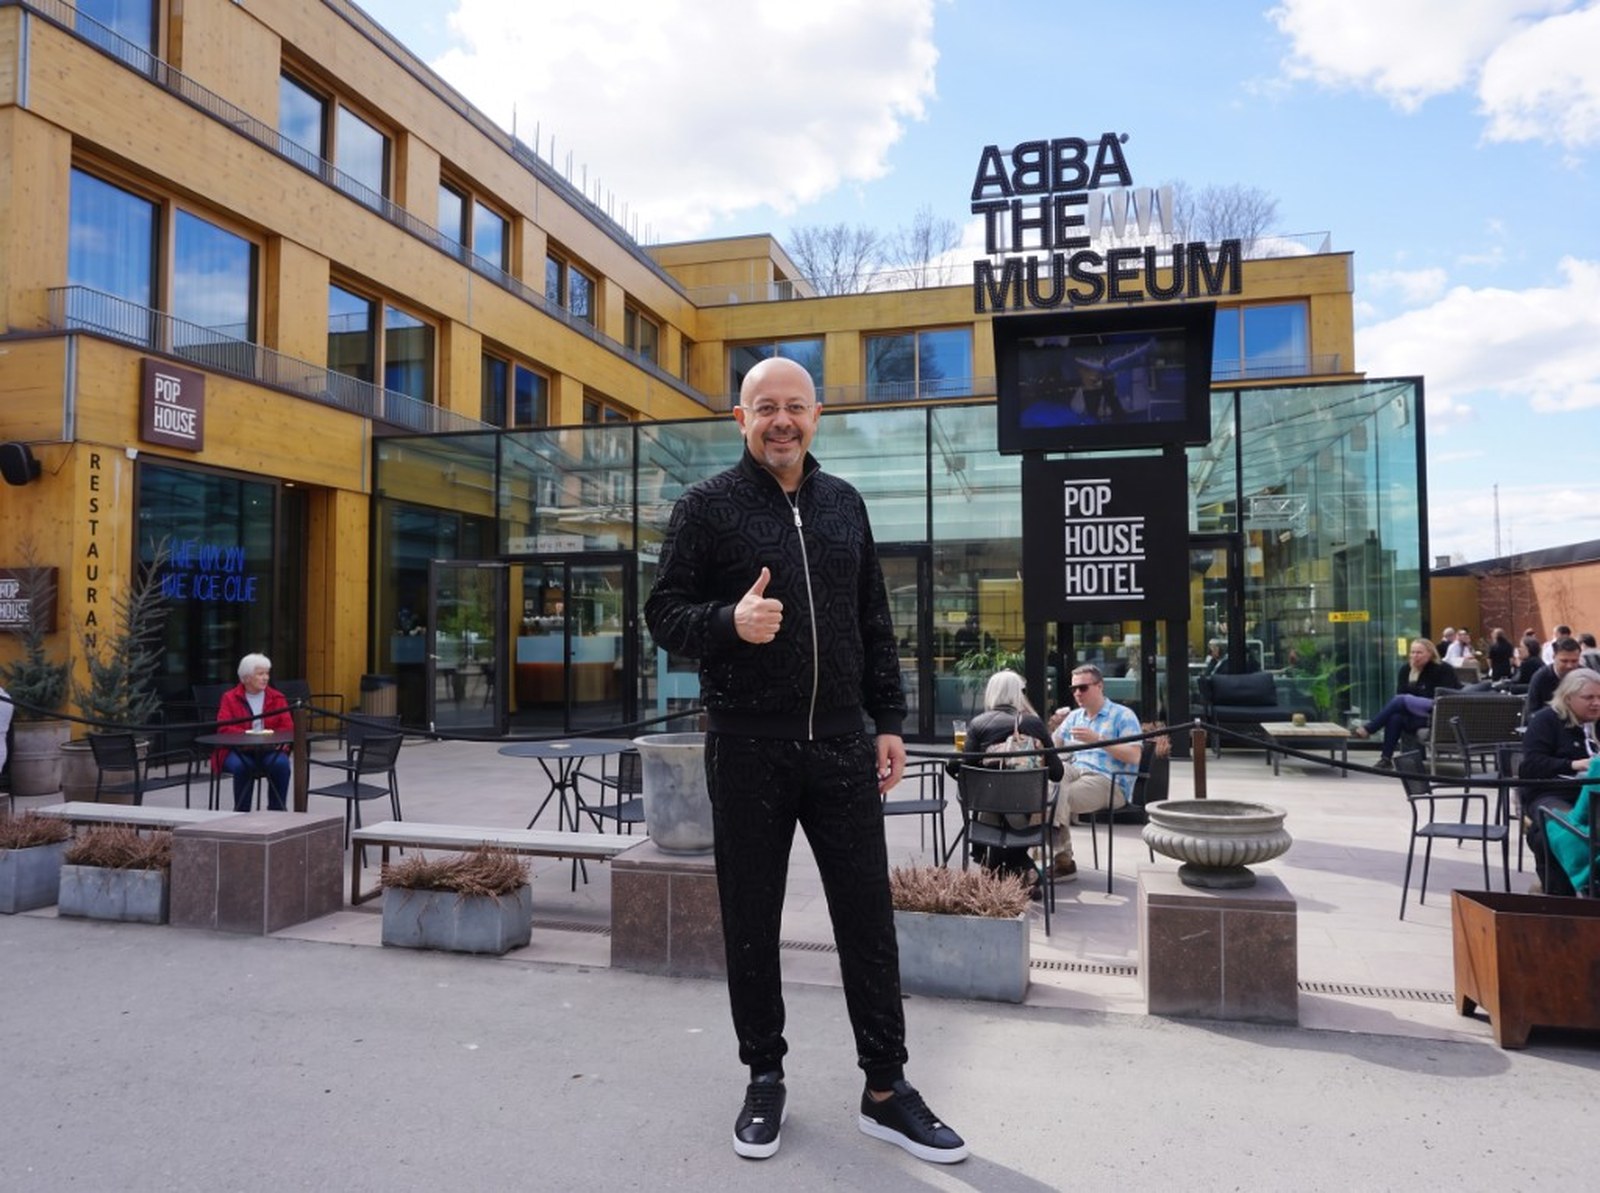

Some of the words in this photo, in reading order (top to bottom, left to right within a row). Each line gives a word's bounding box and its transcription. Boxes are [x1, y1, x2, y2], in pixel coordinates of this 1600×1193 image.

[971, 132, 1132, 201] ABBA
[971, 193, 1091, 255] THE
[973, 238, 1242, 314] MUSEUM
[155, 378, 181, 403] POP
[154, 405, 197, 434] HOUSE
[1064, 486, 1112, 516] POP
[1065, 523, 1145, 555] HOUSE
[86, 452, 101, 673] RESTAURAN
[1065, 563, 1144, 594] HOTEL
